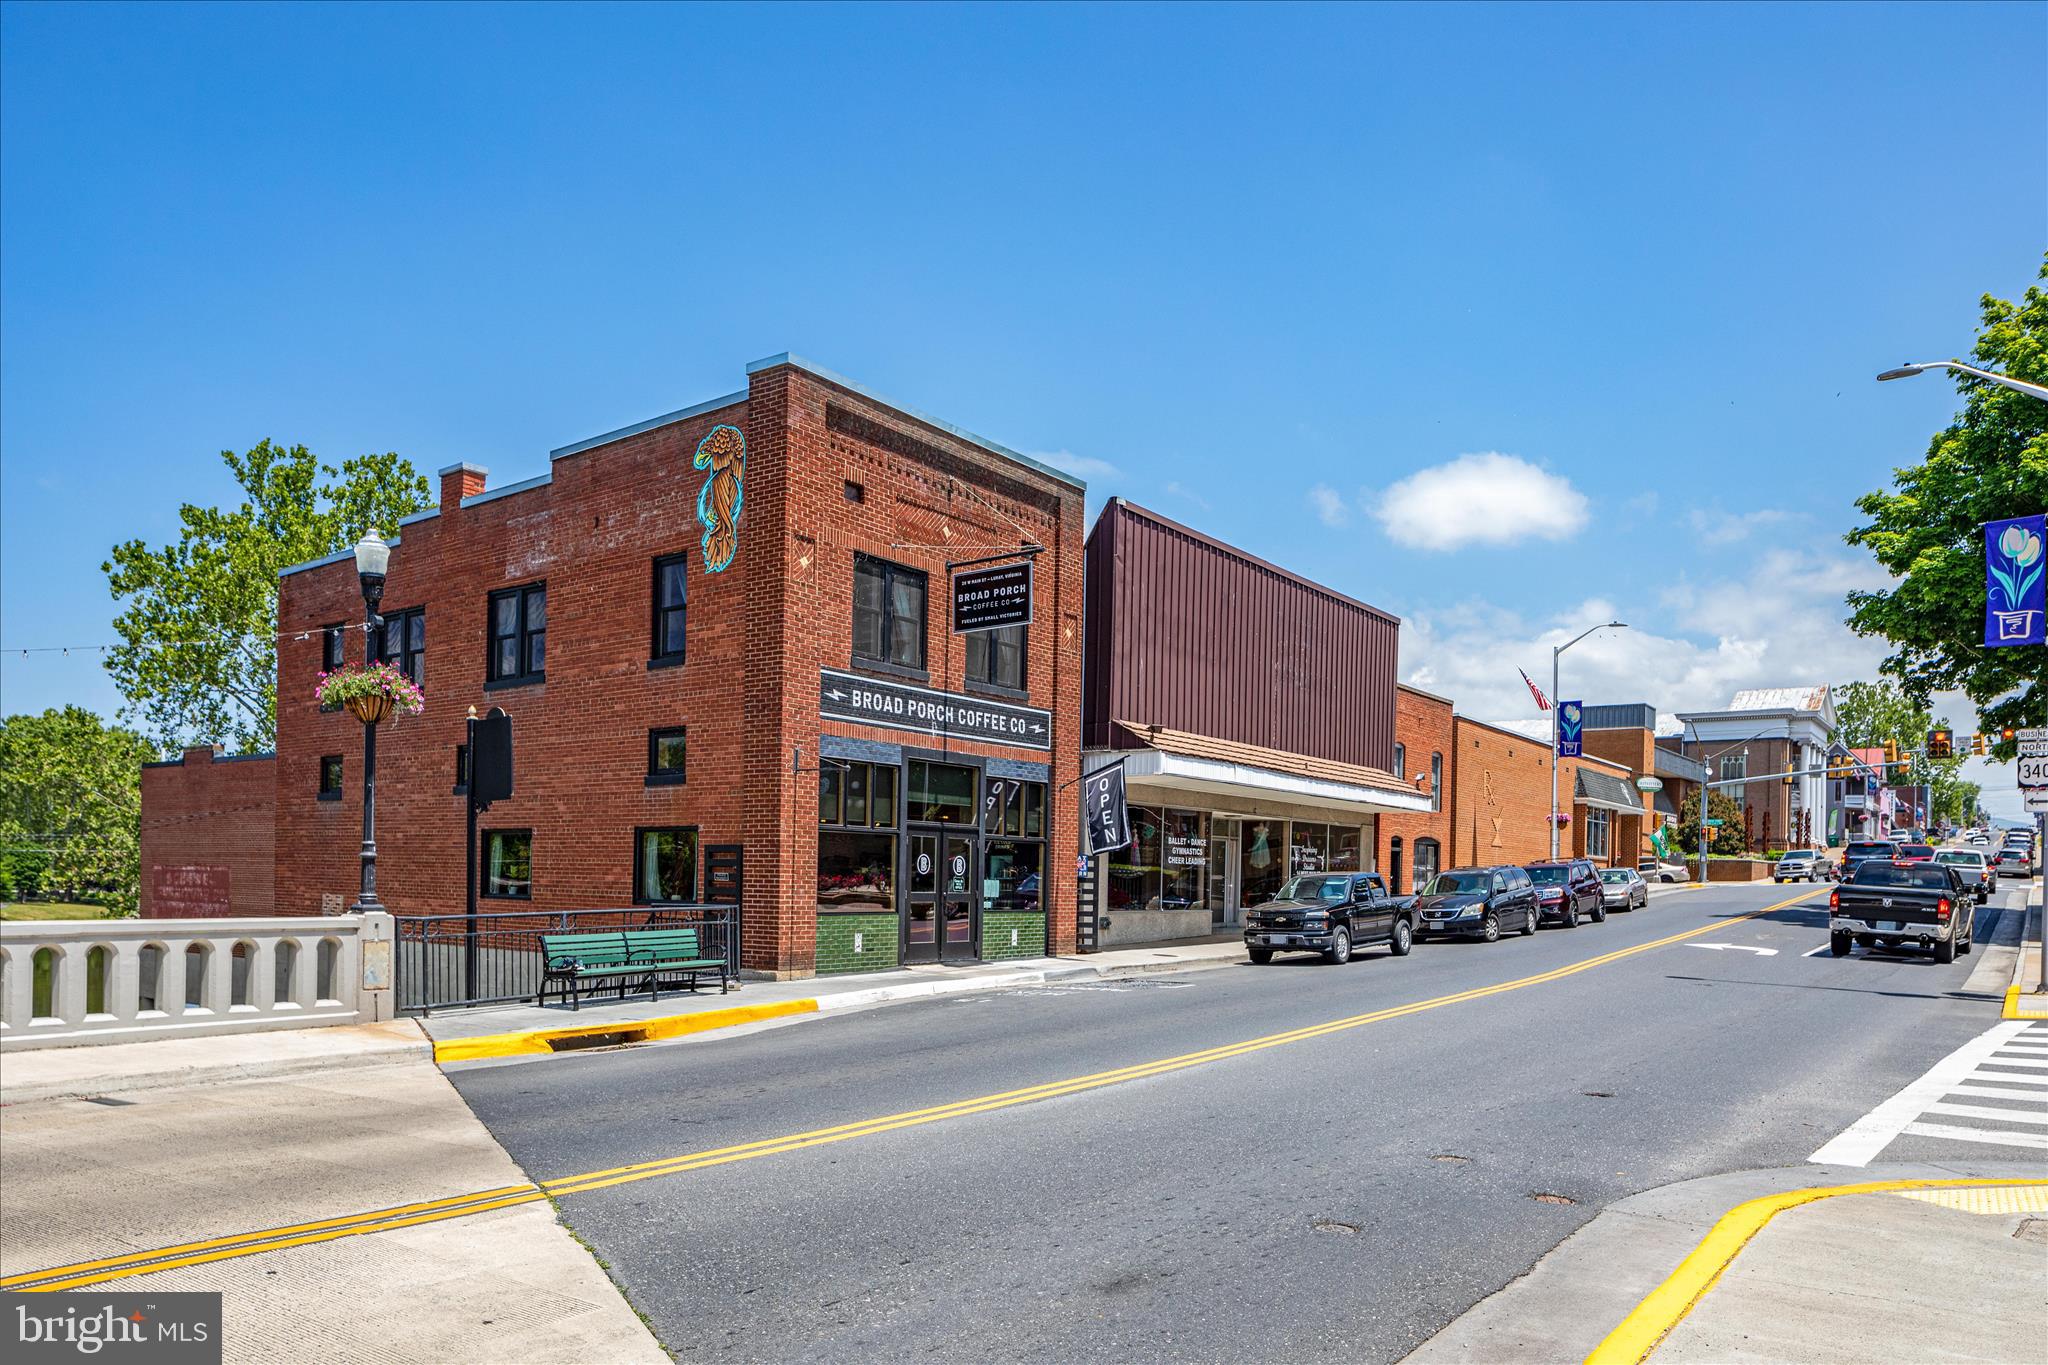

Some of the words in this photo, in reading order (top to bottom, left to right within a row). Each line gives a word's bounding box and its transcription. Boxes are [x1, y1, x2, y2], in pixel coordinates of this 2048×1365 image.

[958, 590, 990, 603] BROAD
[993, 584, 1026, 597] PORCH
[973, 600, 999, 610] COFFEE
[852, 690, 903, 714] BROAD
[908, 700, 954, 723] PORCH
[958, 709, 1006, 731] COFFEE
[1010, 718, 1026, 734] CO
[1100, 778, 1116, 843] OPEN
[1168, 837, 1186, 845] BALLET
[1190, 838, 1207, 846] DANCE
[1172, 847, 1203, 856] GYMNASTICS
[1186, 857, 1206, 866] LEADING
